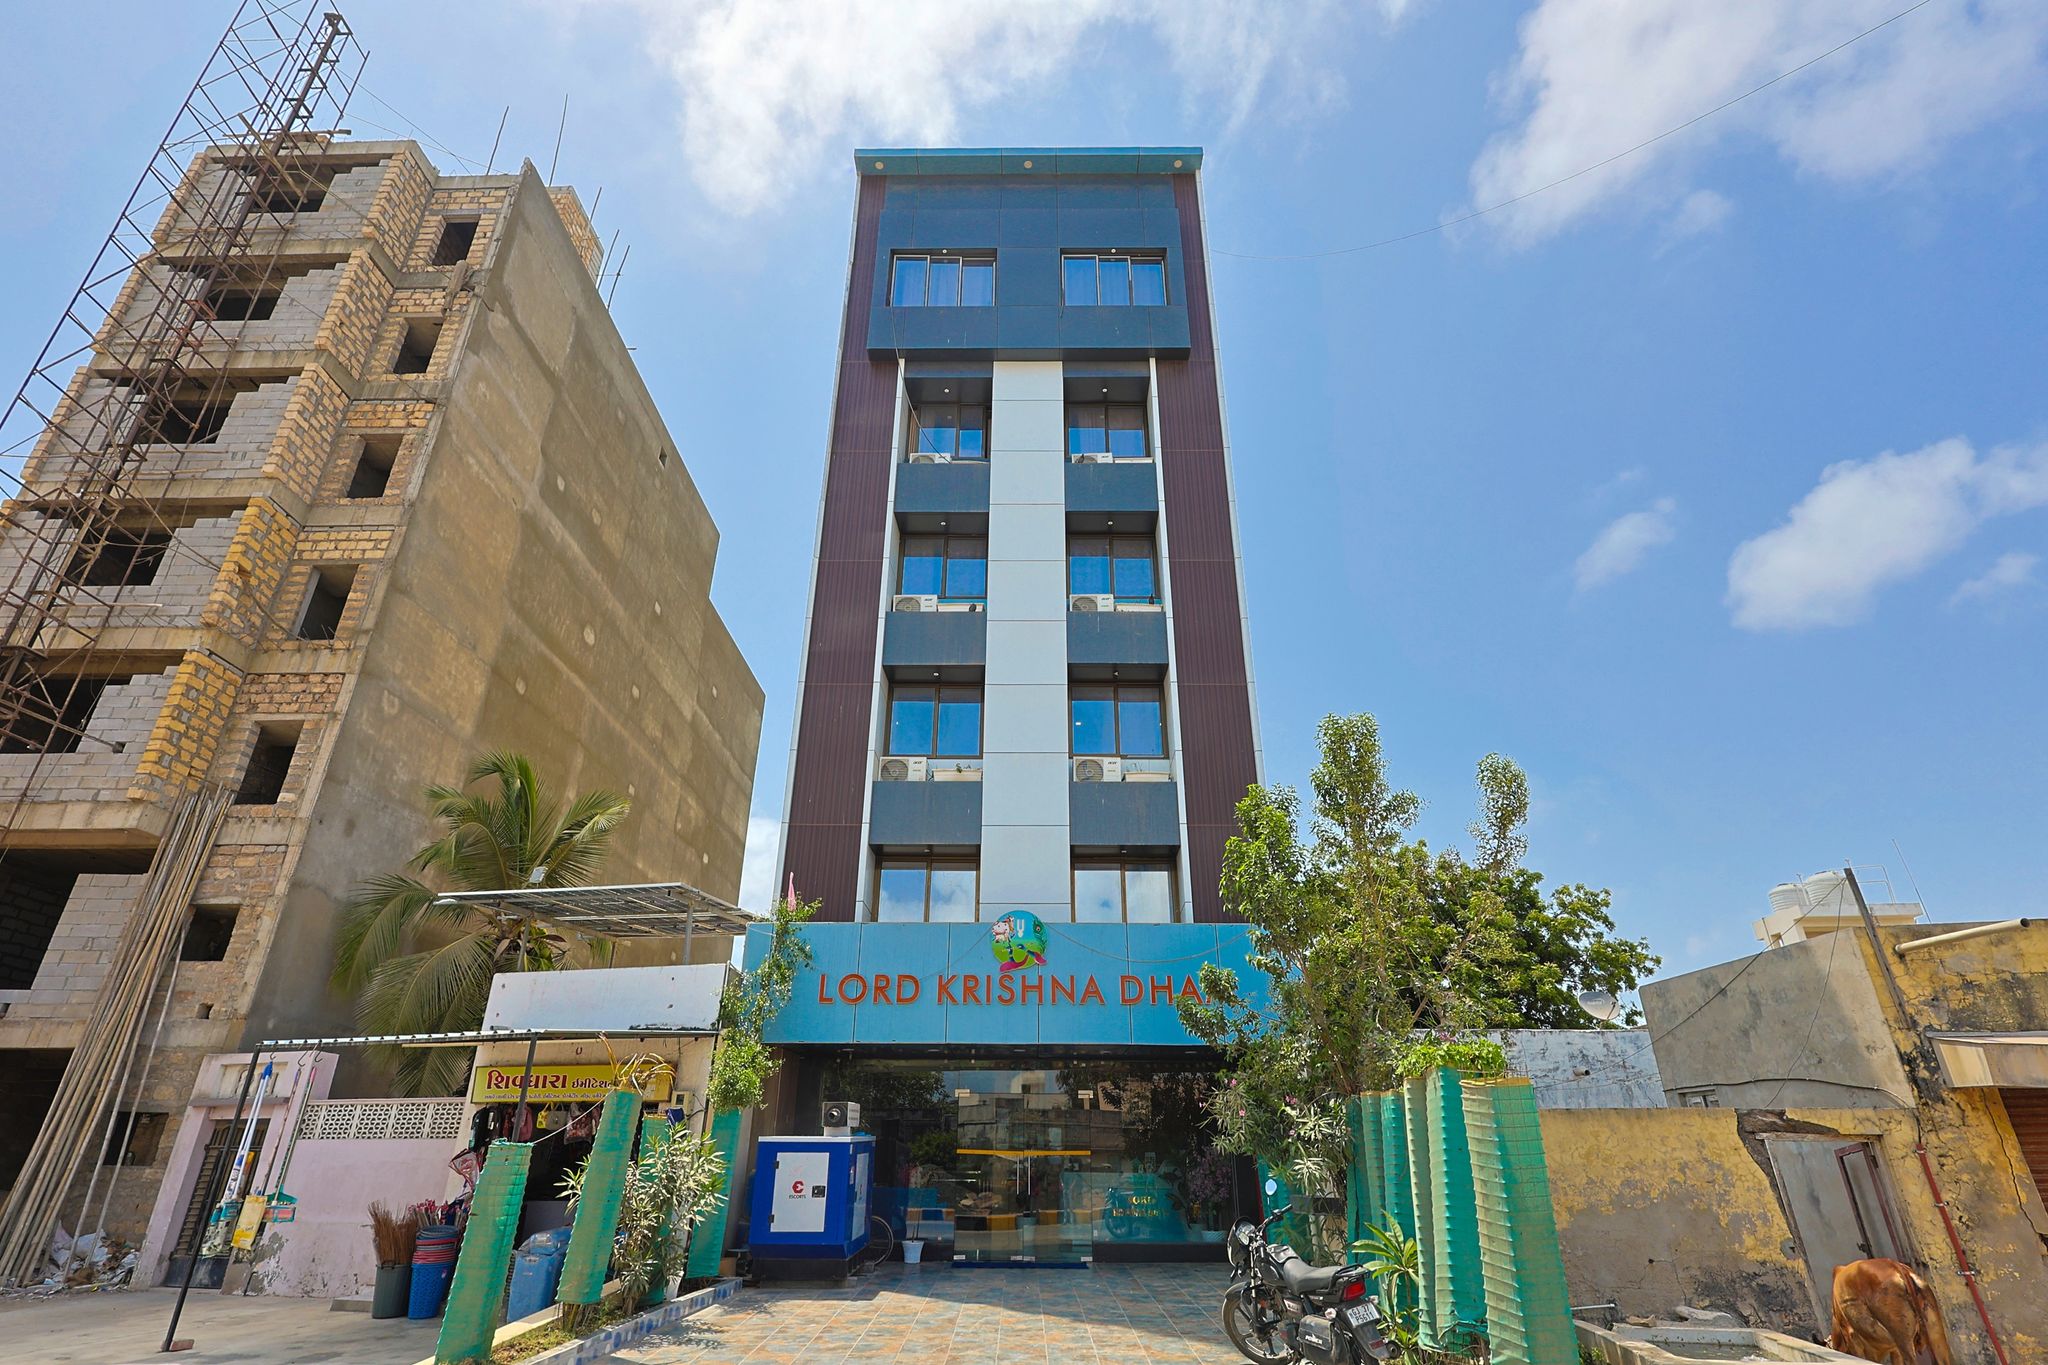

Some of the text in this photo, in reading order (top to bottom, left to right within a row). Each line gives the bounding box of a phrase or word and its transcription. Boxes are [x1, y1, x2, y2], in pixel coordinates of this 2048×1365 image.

[818, 973, 1212, 1005] LORD KRISHNA DHA
[1351, 1307, 1361, 1316] GJ
[1361, 1304, 1370, 1313] 37
[1355, 1311, 1375, 1324] P5611
